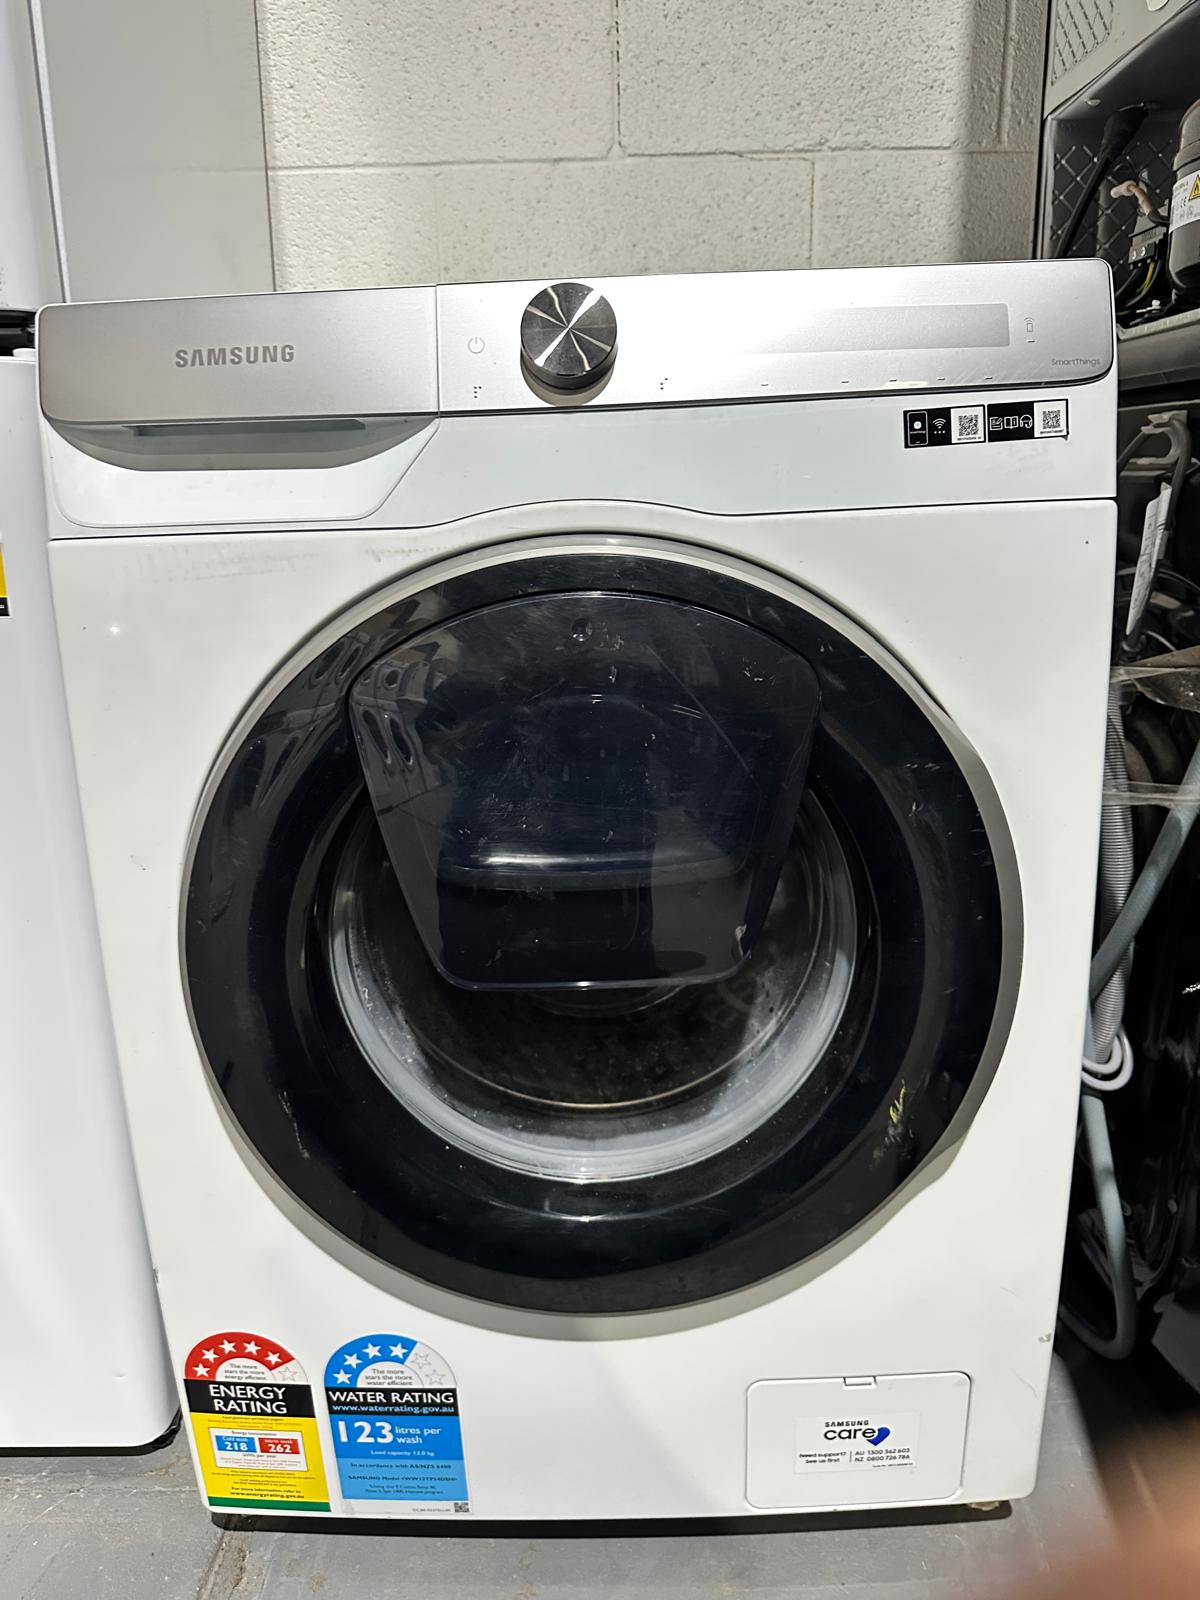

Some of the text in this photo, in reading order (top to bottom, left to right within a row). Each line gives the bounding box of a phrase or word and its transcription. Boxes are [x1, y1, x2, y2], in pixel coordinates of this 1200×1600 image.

[175, 344, 295, 368] SAMSUNG
[1051, 358, 1101, 367] SmartThings
[209, 1384, 286, 1399] ENERGY
[328, 1391, 454, 1403] WATER RATING
[213, 1399, 287, 1414] RATING
[332, 1404, 454, 1414] www.waterrating.gov.au
[338, 1420, 394, 1444] 123
[395, 1426, 442, 1436] litres per
[824, 1428, 876, 1440] care
[396, 1436, 423, 1444] wash
[224, 1442, 248, 1451] 218
[268, 1444, 292, 1453] 262
